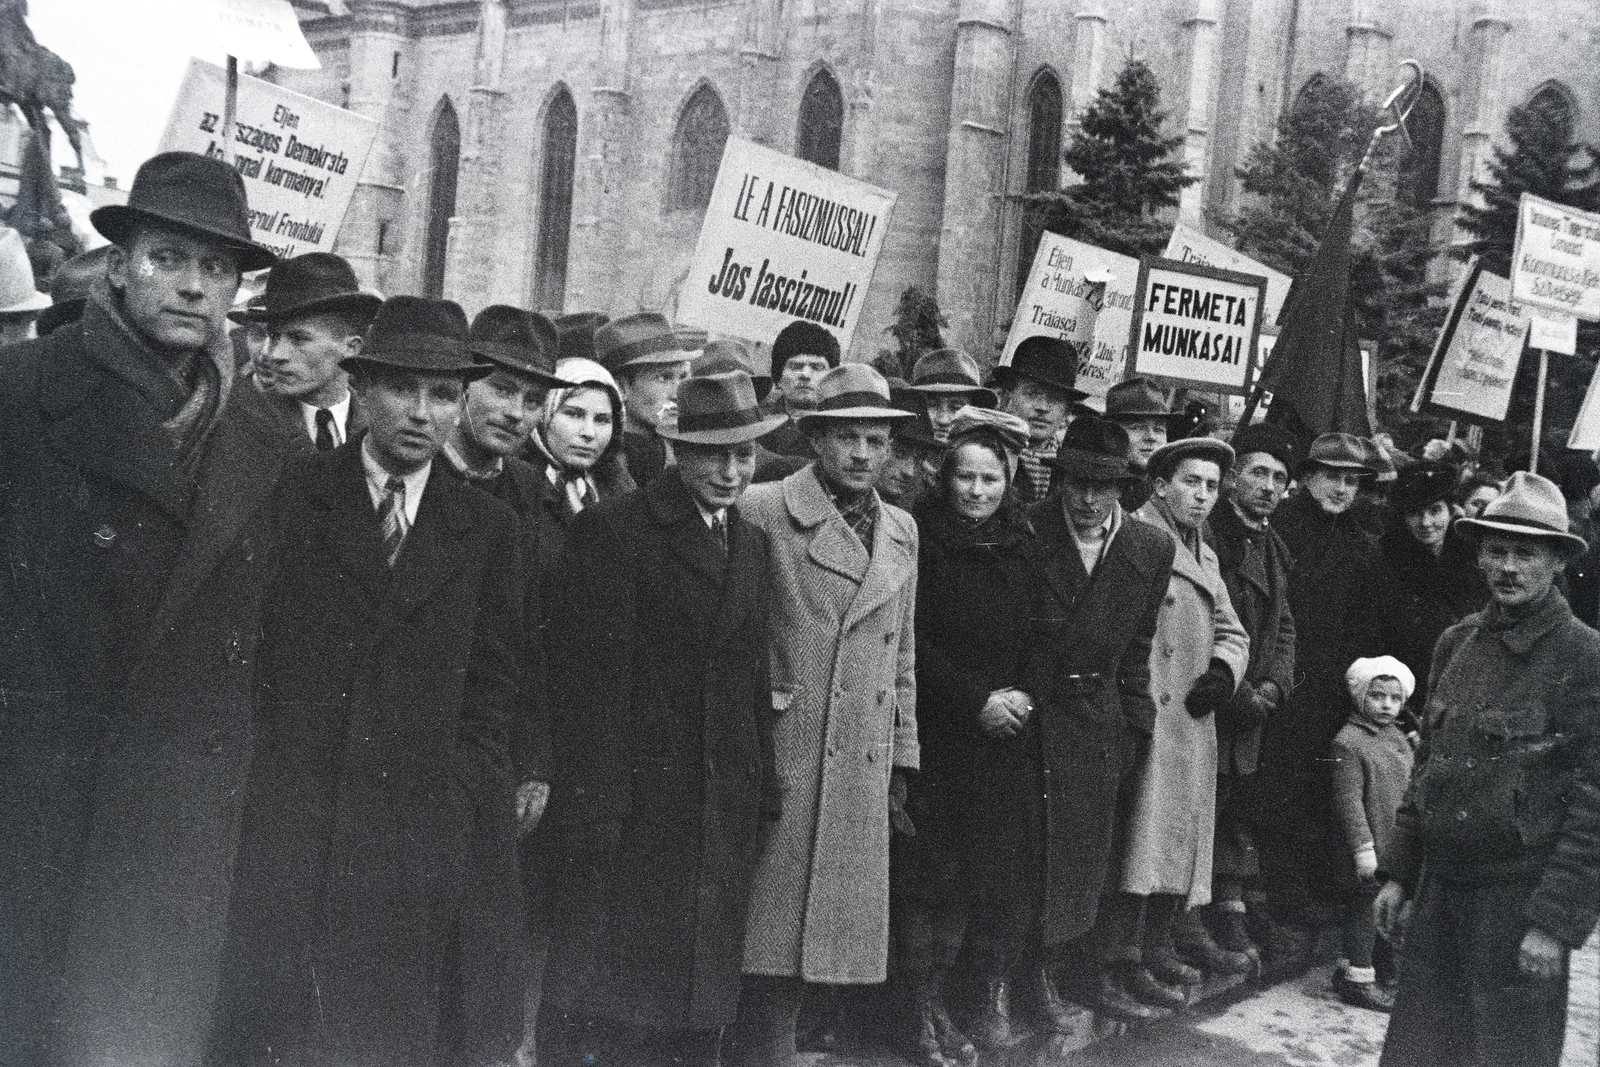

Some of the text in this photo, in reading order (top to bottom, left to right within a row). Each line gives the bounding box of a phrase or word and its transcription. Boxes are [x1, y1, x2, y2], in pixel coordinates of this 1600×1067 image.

[284, 134, 349, 176] Demokrata
[265, 159, 331, 199] kormánya!
[277, 212, 326, 245] Frontului
[733, 173, 878, 258] LE A FASIZMUSSAL!
[708, 247, 753, 302] Jos
